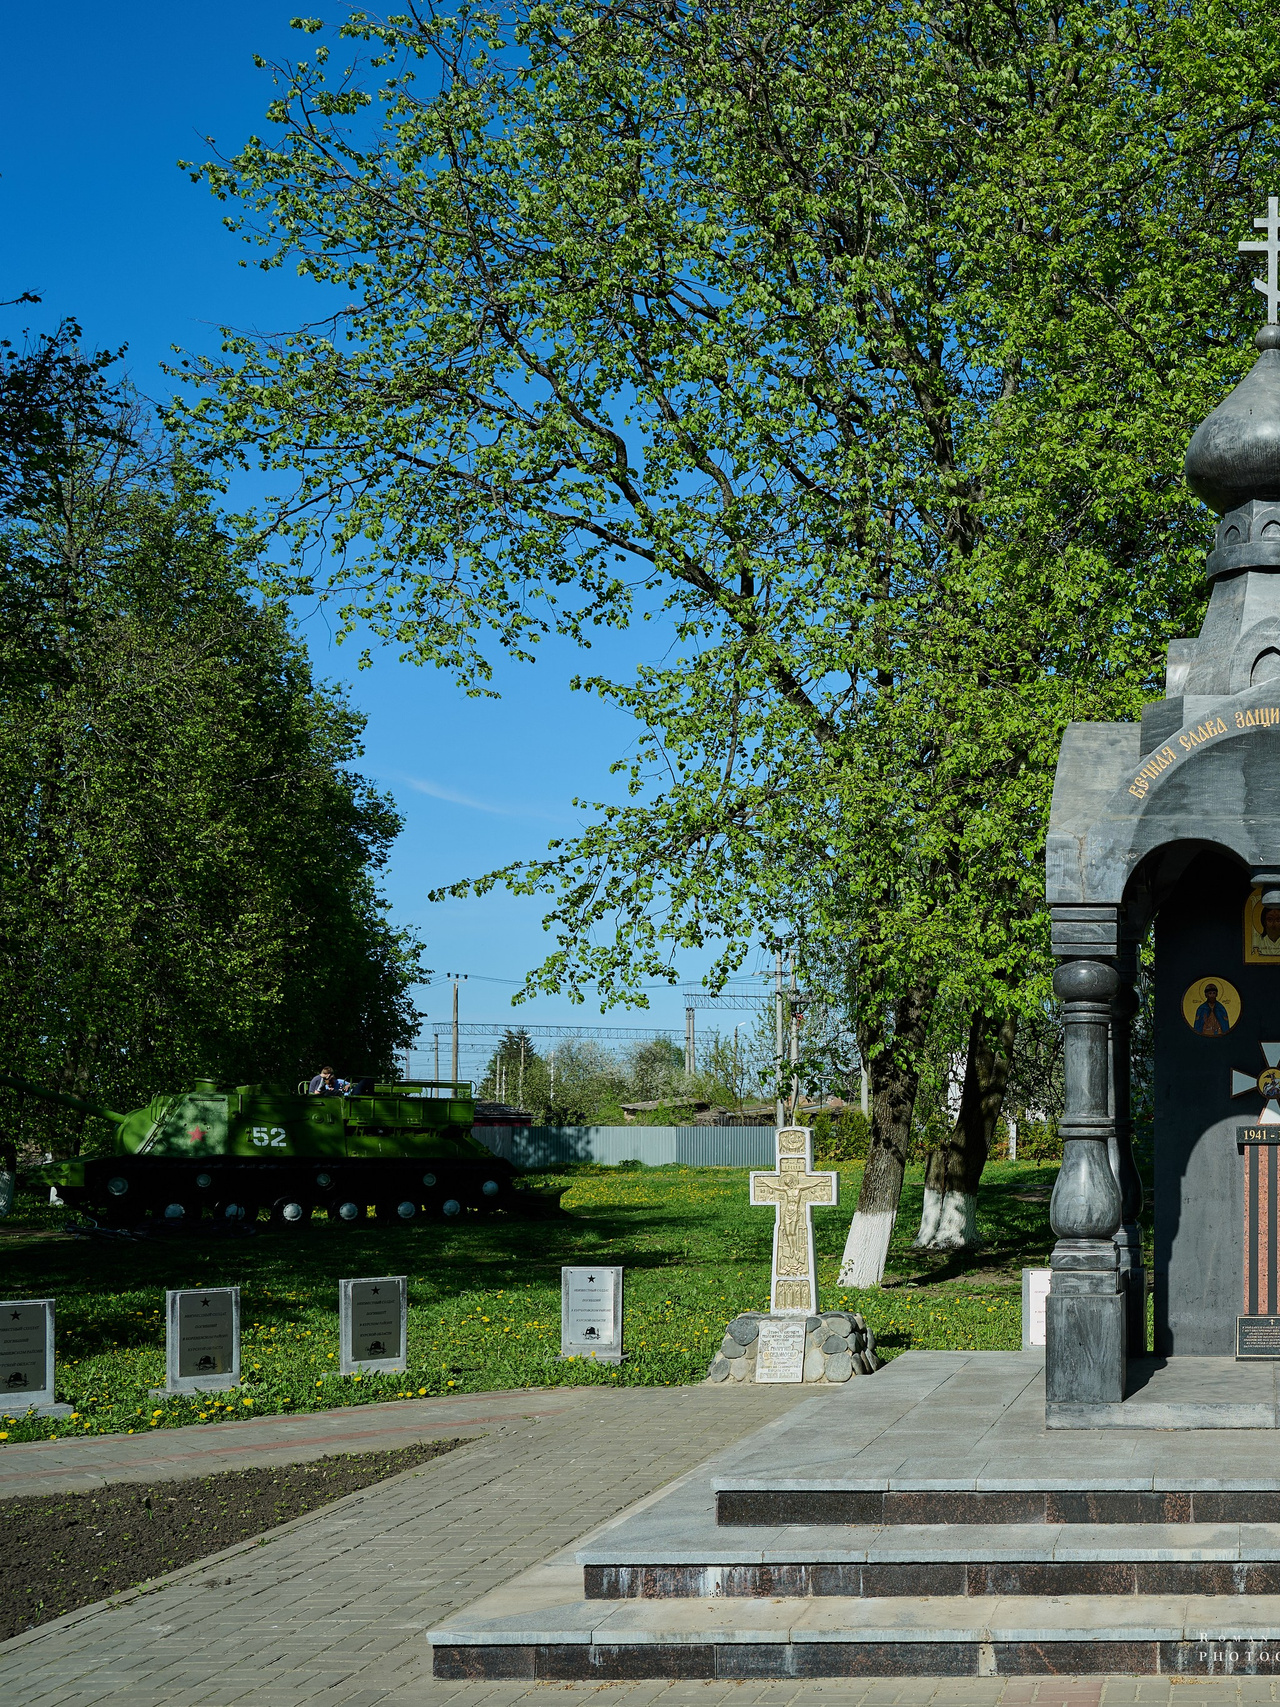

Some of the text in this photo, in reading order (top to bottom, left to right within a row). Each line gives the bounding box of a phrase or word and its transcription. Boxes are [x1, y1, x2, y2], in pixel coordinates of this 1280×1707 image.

[1127, 745, 1177, 800] ВЕЧНАЯ
[1178, 716, 1228, 752] СЛАВА
[252, 1127, 287, 1147] 52
[1243, 1129, 1267, 1140] 1941
